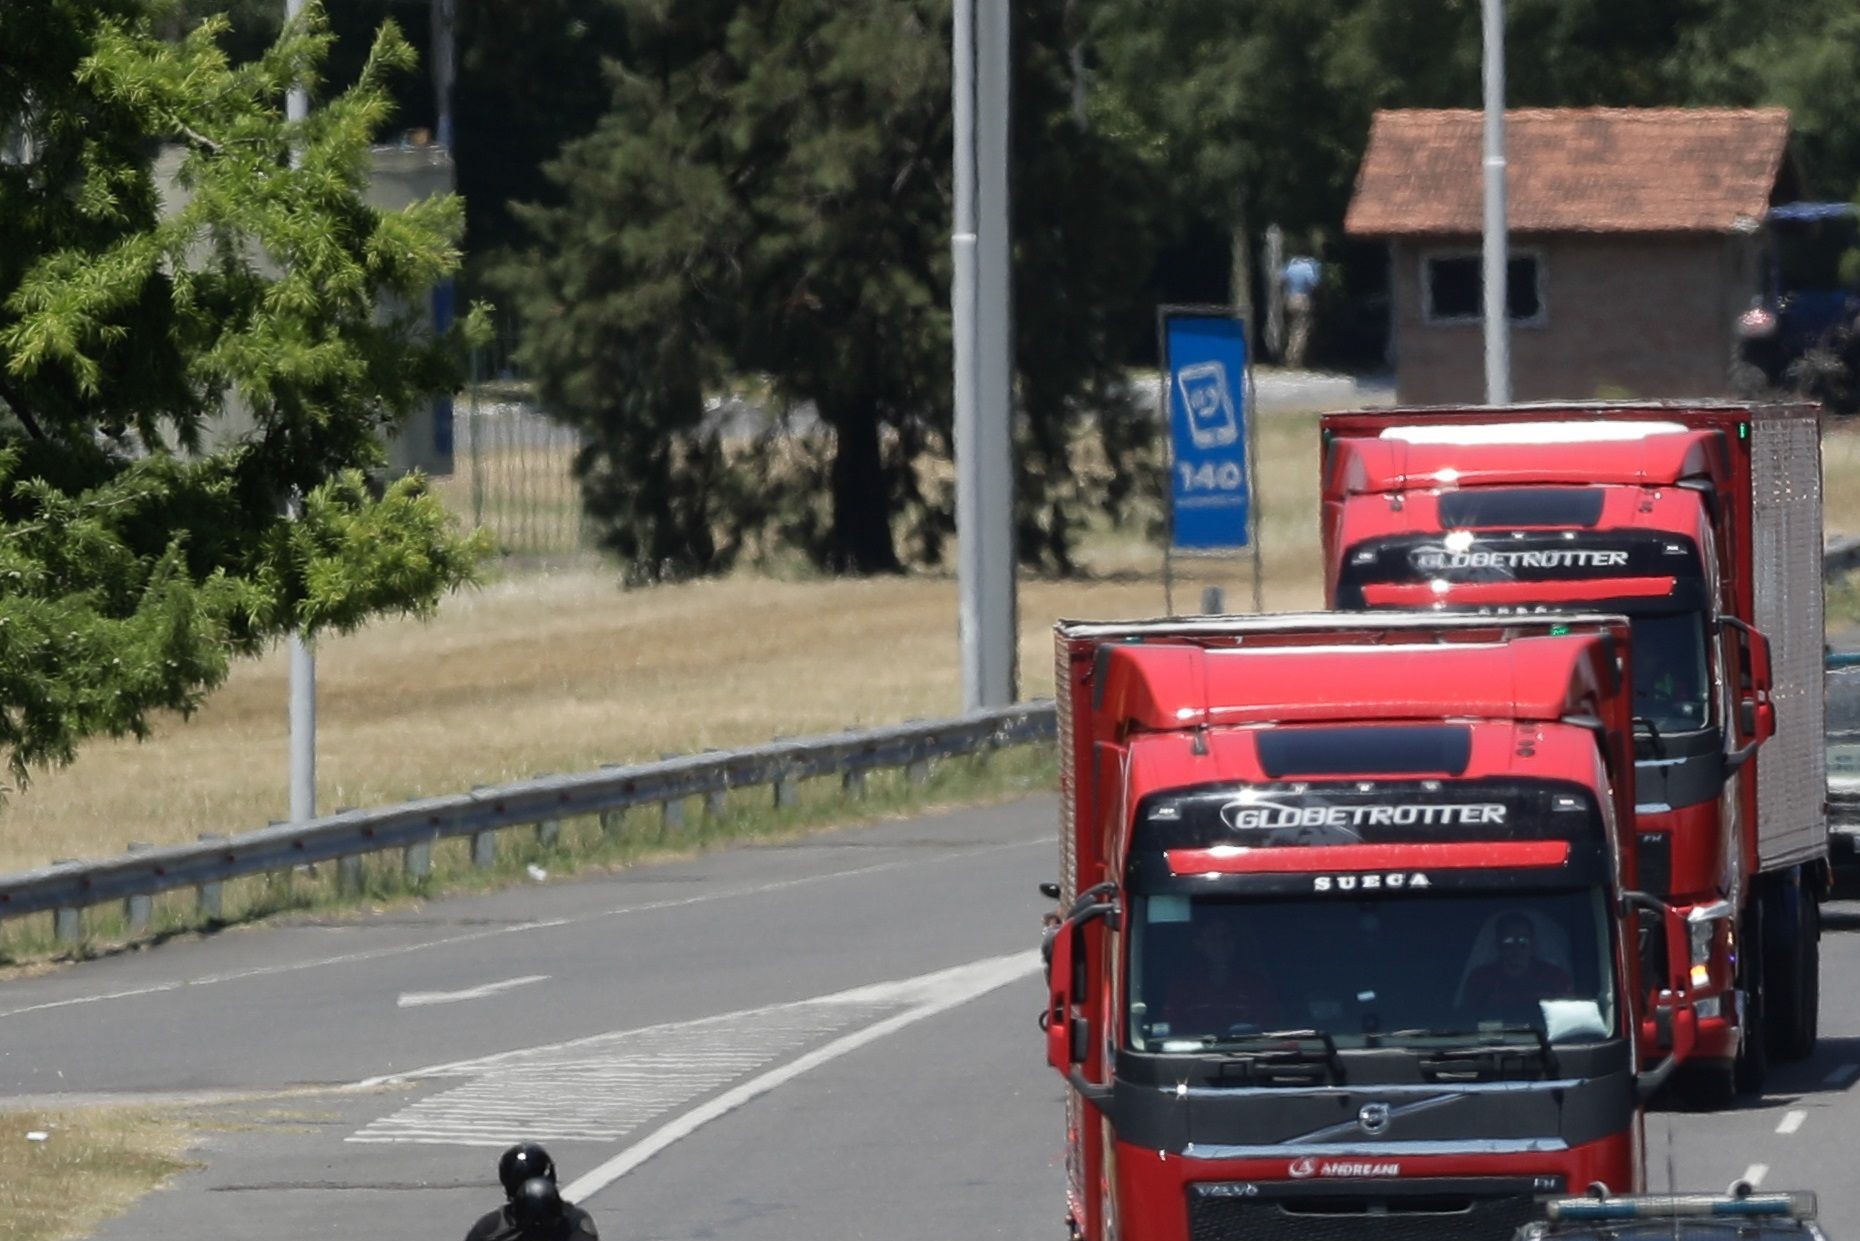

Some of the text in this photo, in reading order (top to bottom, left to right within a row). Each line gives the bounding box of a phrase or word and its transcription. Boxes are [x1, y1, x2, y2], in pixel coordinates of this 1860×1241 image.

[1180, 462, 1241, 492] 140
[1417, 551, 1629, 570] GLOBETROTTER
[1235, 803, 1507, 829] GLOBETROTTER
[1313, 873, 1431, 890] SUECA
[1320, 1162, 1399, 1176] ANDREANI
